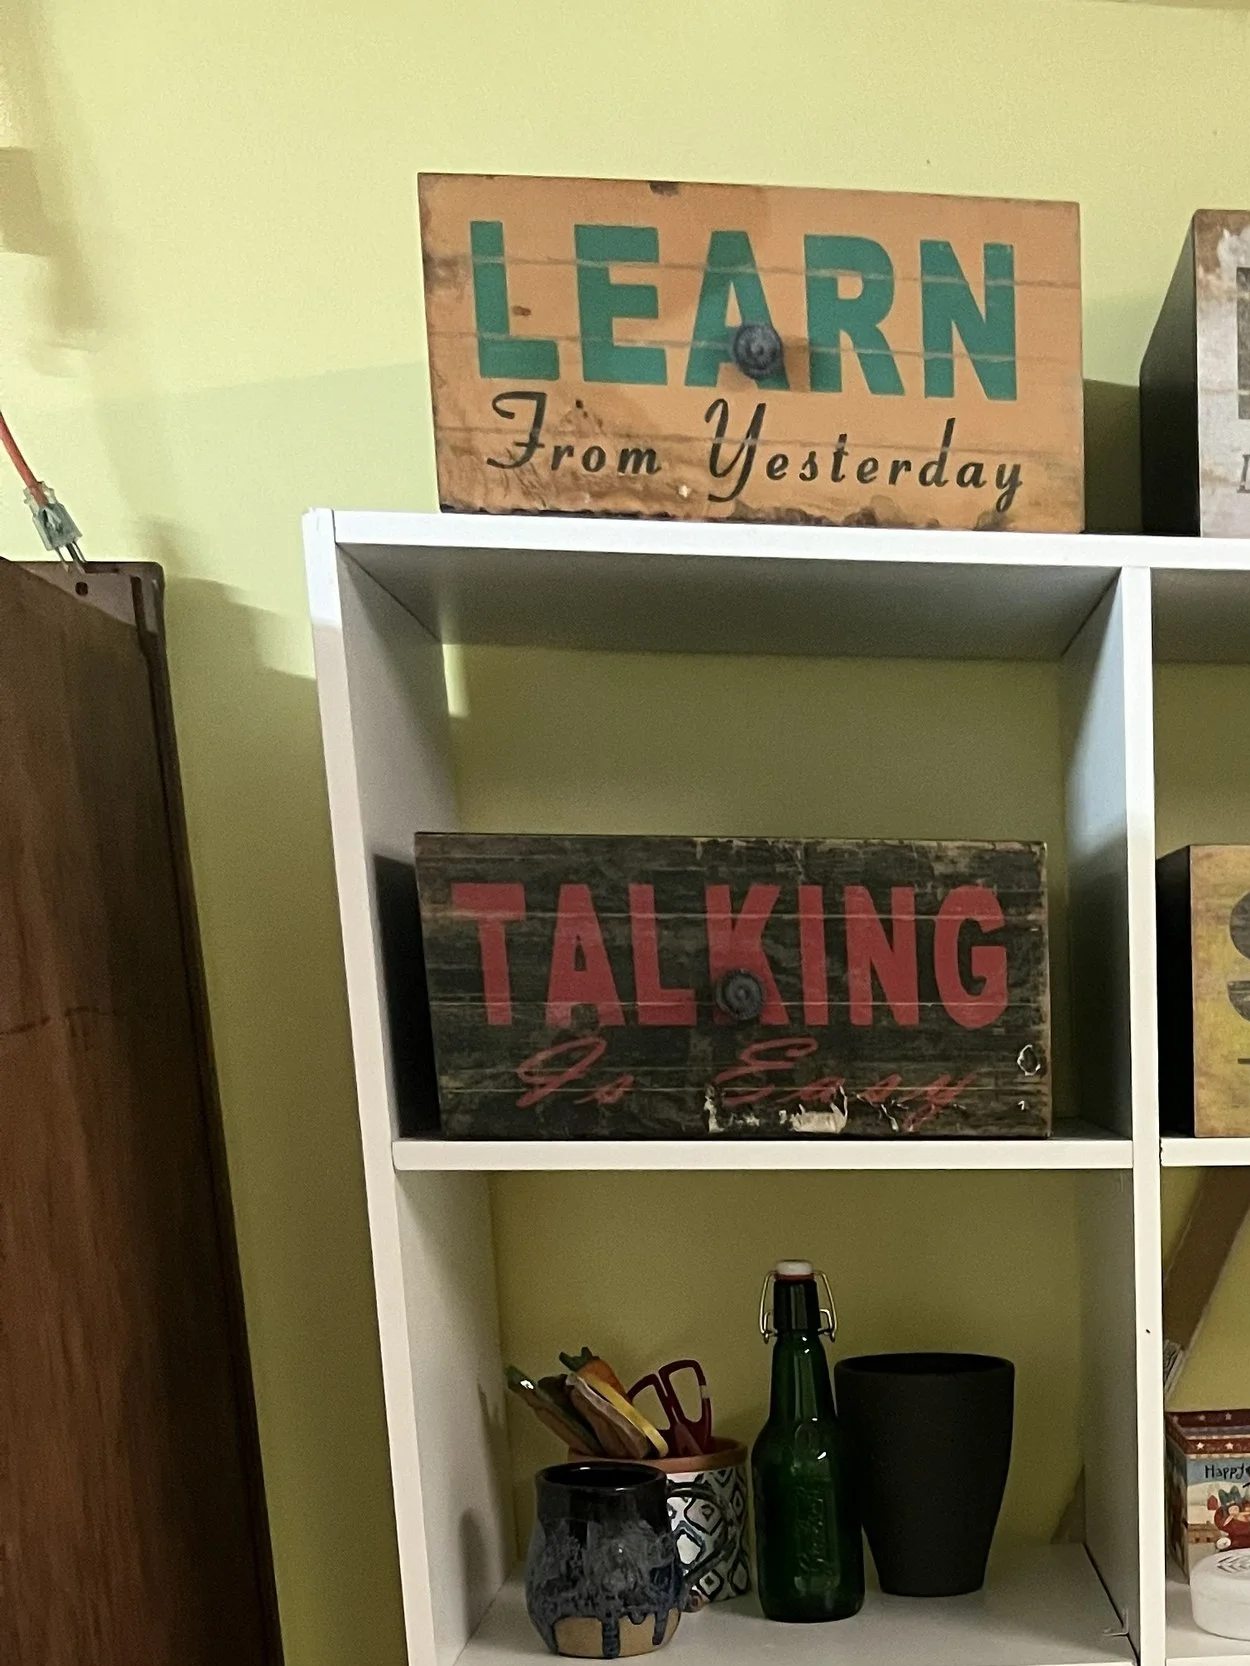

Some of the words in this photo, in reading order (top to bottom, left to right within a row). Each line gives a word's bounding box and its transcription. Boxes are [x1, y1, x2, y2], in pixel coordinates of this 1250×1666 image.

[470, 220, 1018, 401] LEARN
[486, 390, 660, 476] From
[703, 398, 1023, 513] Yesterday
[451, 882, 1010, 1029] TALKING
[712, 1036, 978, 1131] Easy
[1204, 1463, 1247, 1481] Happy
